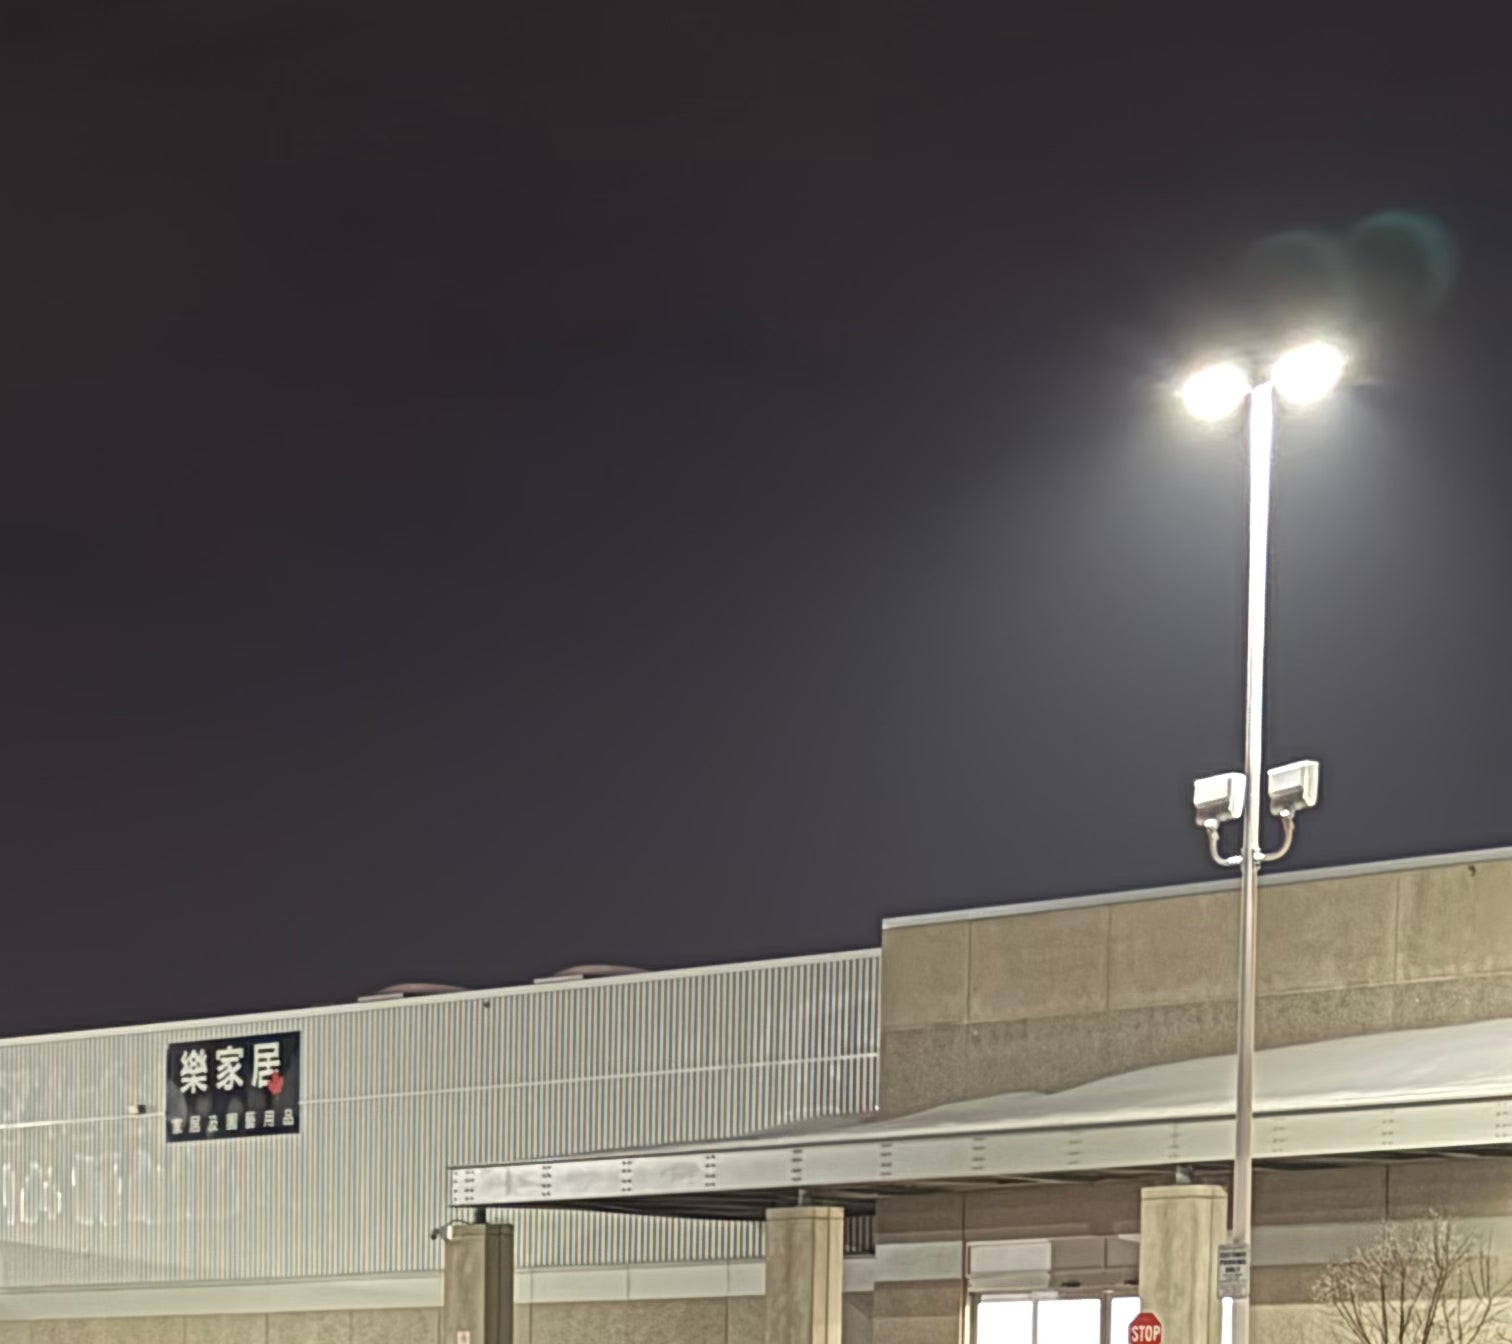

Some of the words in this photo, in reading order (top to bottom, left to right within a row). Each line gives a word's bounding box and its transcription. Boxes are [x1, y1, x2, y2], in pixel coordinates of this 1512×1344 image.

[180, 1042, 281, 1094] 樂家居
[1131, 1325, 1161, 1342] STOP
